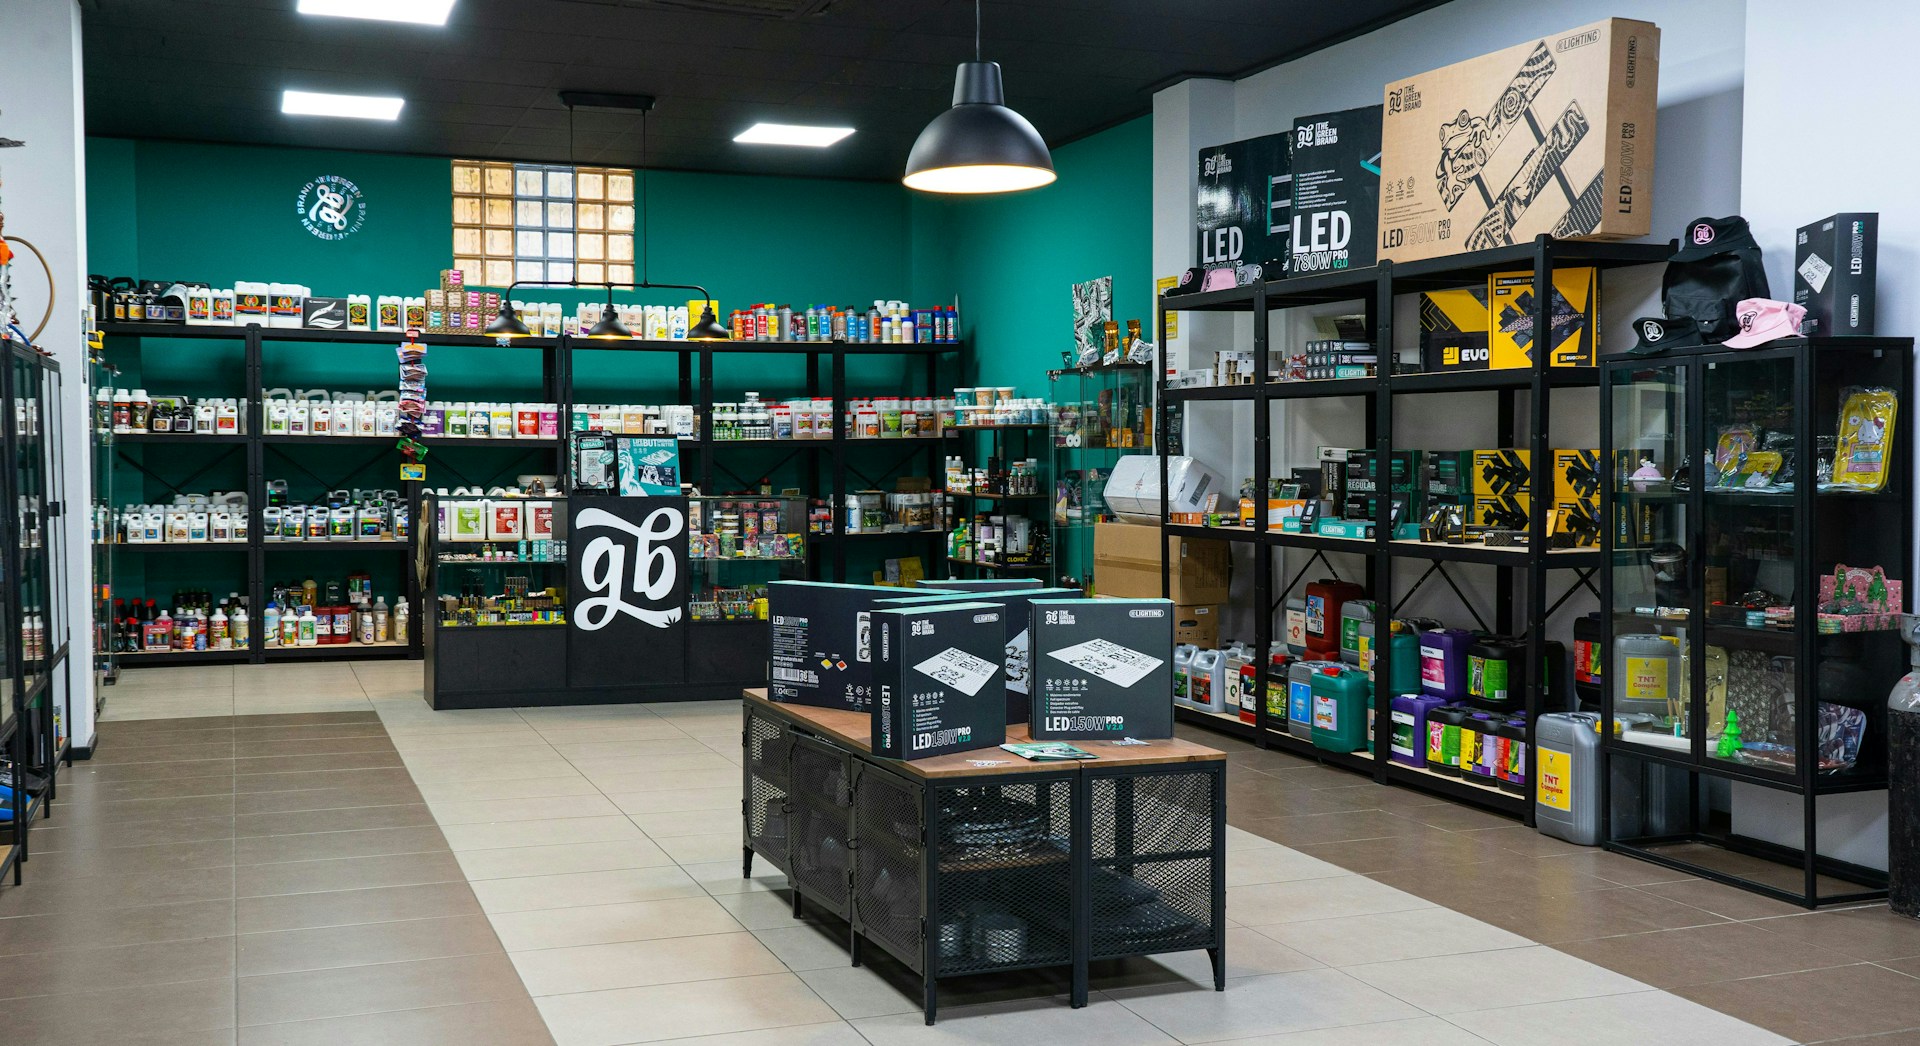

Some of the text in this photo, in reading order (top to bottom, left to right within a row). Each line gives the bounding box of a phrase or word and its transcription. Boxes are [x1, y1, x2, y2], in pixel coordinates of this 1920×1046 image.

[1564, 31, 1598, 50] LIGHTING
[1405, 84, 1415, 94] THE
[1405, 92, 1422, 102] GREEN
[1405, 100, 1422, 112] BRAND
[1317, 122, 1329, 130] THE
[1296, 124, 1314, 148] gb
[1317, 128, 1337, 138] GREEN
[1317, 135, 1338, 146] BRAND
[297, 182, 314, 214] BRAND
[1438, 219, 1451, 230] PRO
[1292, 210, 1352, 254] LED
[1438, 229, 1451, 240] V3.0
[1203, 226, 1243, 264] LED
[1333, 250, 1348, 260] PRO
[1293, 251, 1333, 272] 780W
[1333, 259, 1348, 269] V3.0
[644, 439, 657, 447] BUT
[574, 507, 684, 630] gb
[958, 726, 971, 736] PRO
[1545, 774, 1559, 785] TNT
[1541, 782, 1563, 794] Complex
